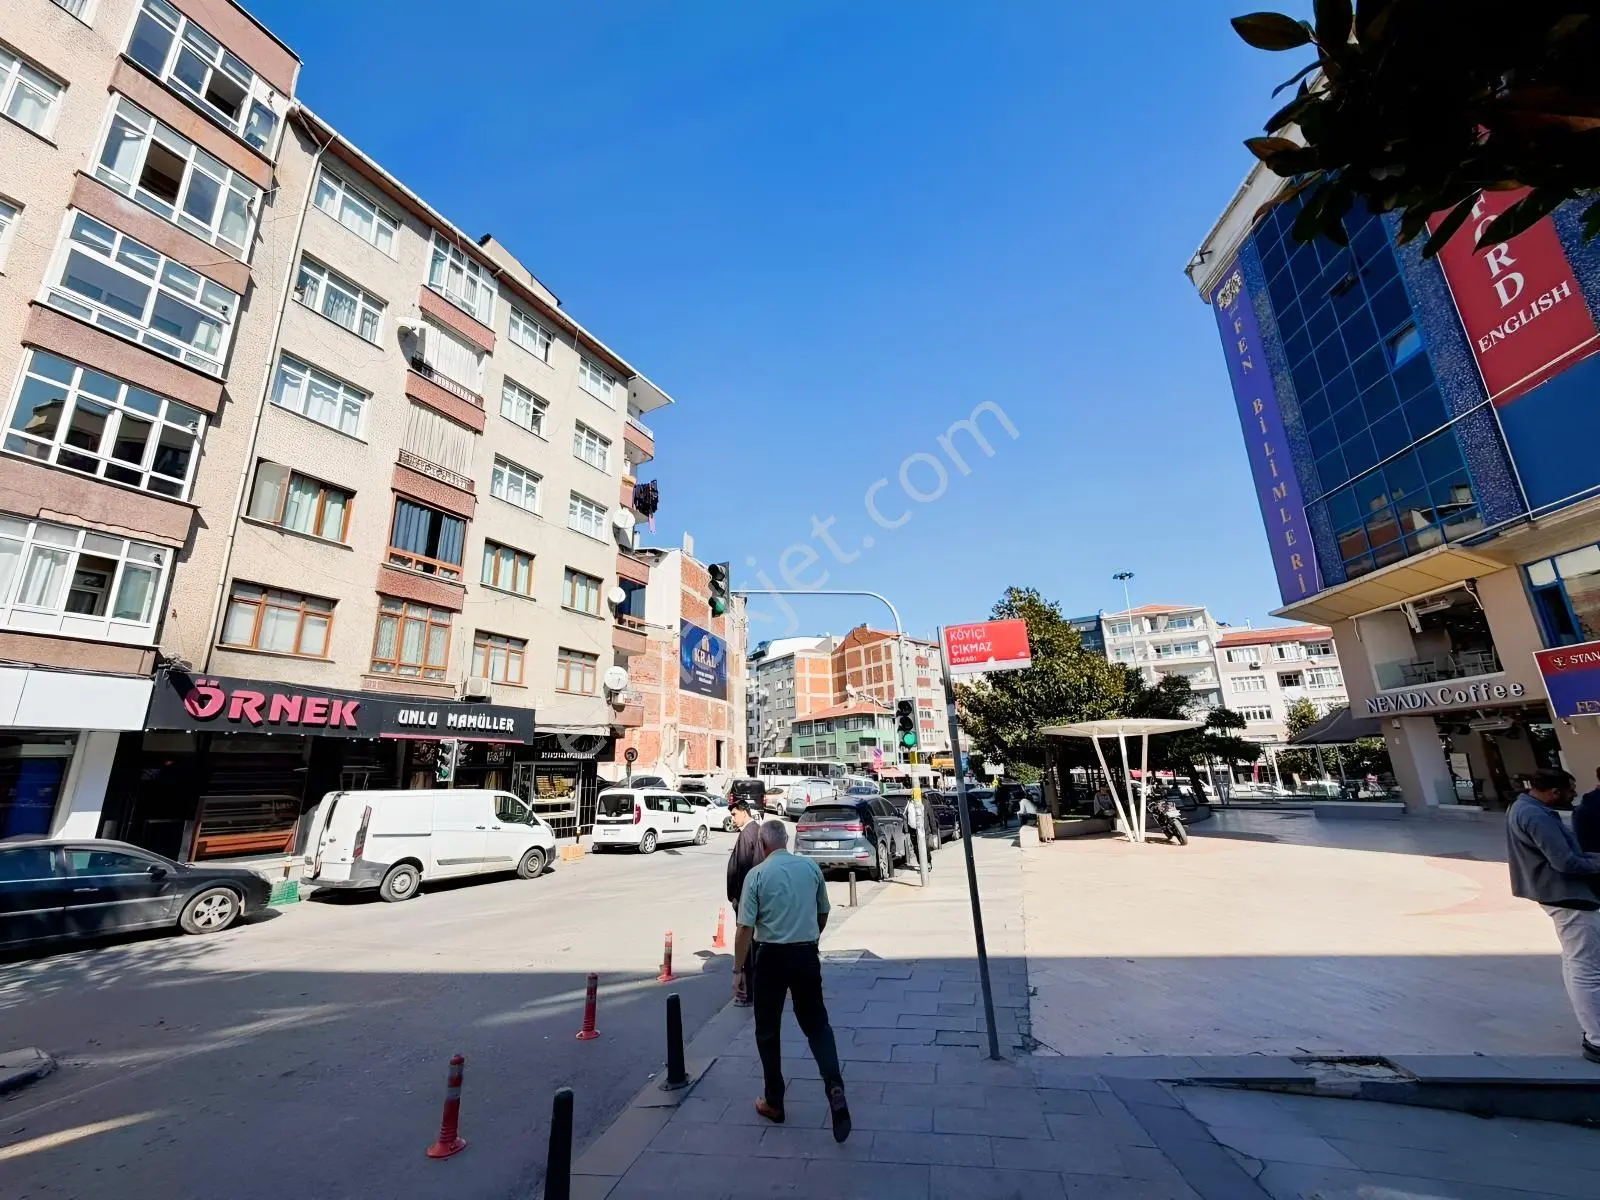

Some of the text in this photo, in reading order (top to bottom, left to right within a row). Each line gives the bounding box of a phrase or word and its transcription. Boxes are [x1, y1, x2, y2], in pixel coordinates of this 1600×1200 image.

[1477, 280, 1572, 353] ENGLISH
[1234, 317, 1307, 593] FEN BİLİMLERİ
[693, 647, 717, 668] KRAL
[951, 641, 992, 656] ÇIKMAZ
[1570, 651, 1600, 664] STAN
[184, 679, 360, 728] ÖRNEK
[1366, 682, 1524, 714] NEVADA Coffee
[446, 713, 514, 732] MAMÜLLER
